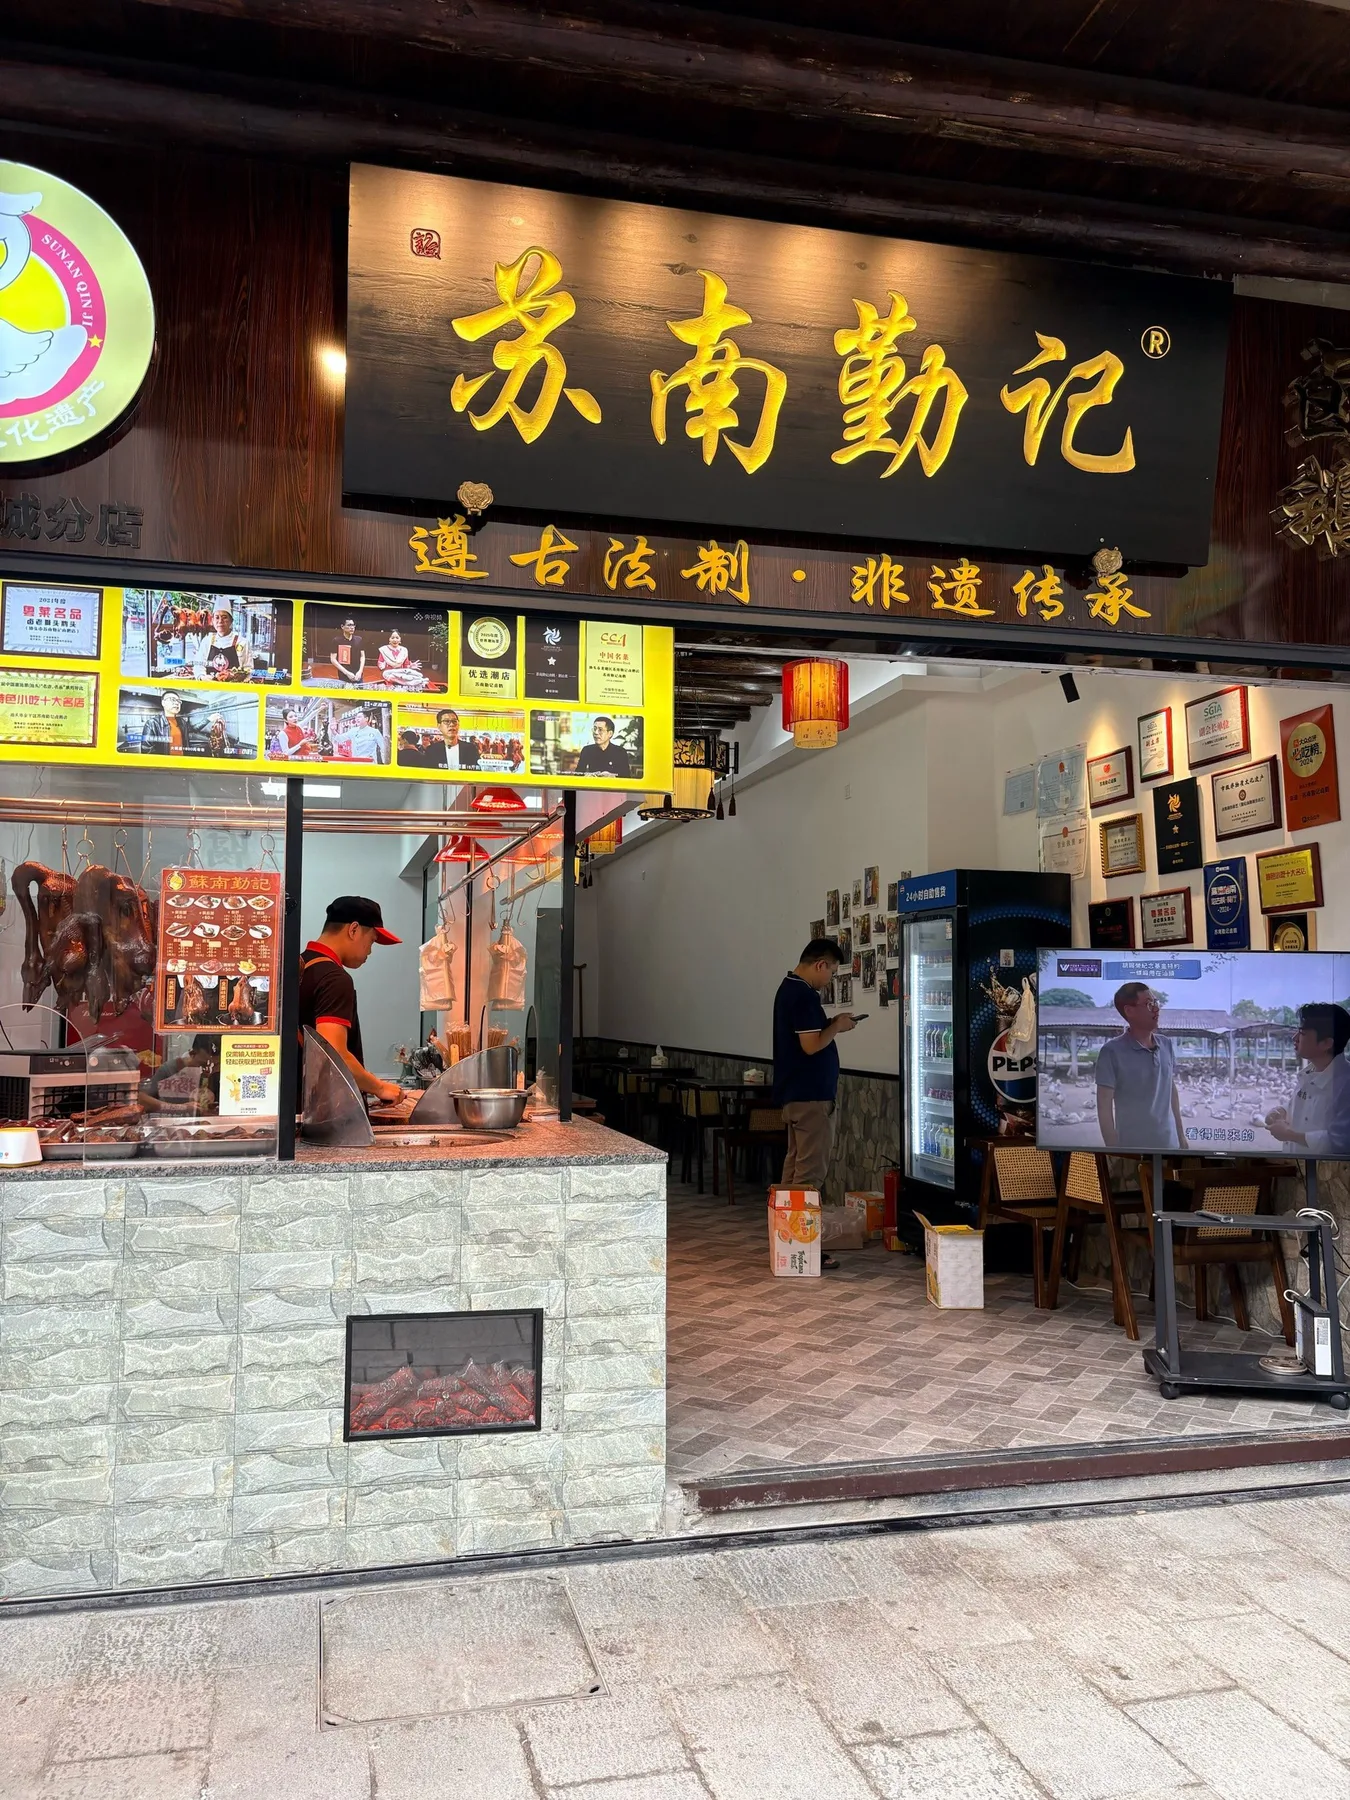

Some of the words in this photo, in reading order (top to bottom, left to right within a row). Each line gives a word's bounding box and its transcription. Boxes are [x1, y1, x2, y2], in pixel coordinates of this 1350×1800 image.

[41, 234, 83, 279] SUNAN
[76, 281, 93, 309] QIN
[82, 312, 93, 327] JI
[451, 246, 1136, 479] 苏南勤记
[0, 380, 105, 448] 化遗产
[468, 669, 510, 681] 优选潮店
[1300, 758, 1314, 767] 2024
[188, 875, 272, 892] 蘇南勤記
[905, 885, 946, 902] 24小时自助售货
[1185, 1127, 1255, 1142] 看得出來的
